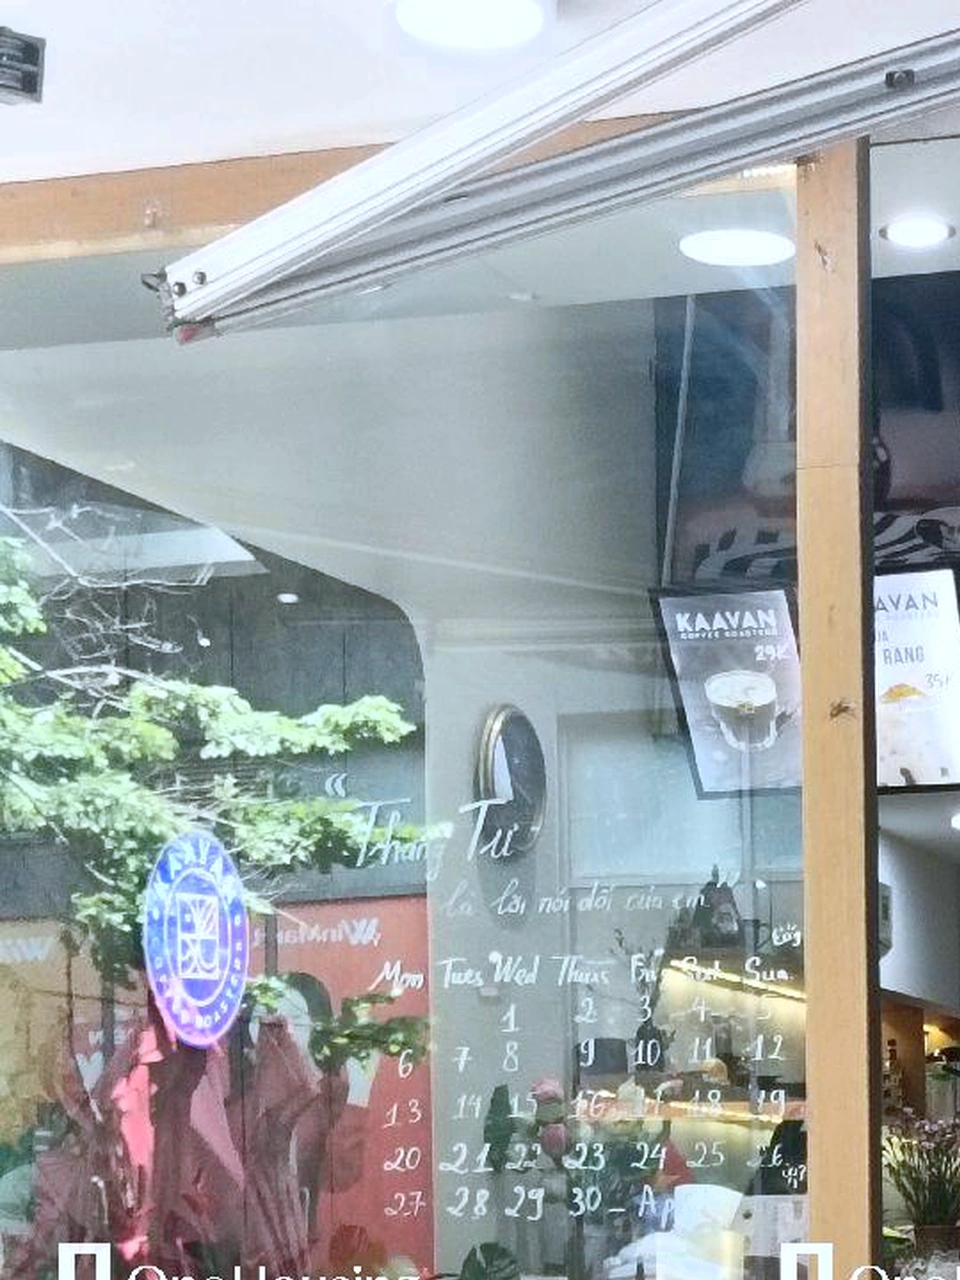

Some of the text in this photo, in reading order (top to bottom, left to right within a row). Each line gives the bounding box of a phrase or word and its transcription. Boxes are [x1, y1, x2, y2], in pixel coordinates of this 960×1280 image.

[876, 591, 938, 612] AVAN
[675, 609, 777, 632] KAAVAN
[368, 959, 425, 992] Mon
[437, 956, 485, 989] Tues
[492, 954, 541, 986] Wed
[500, 1004, 520, 1033] 1
[574, 998, 598, 1023] 2
[637, 994, 652, 1022] 3
[691, 996, 710, 1022] 4
[397, 1034, 788, 1078] 6 7 8 9 10 11 12
[382, 1099, 422, 1129] 13
[451, 1094, 482, 1120] 14
[757, 1089, 786, 1122] 19
[383, 1147, 421, 1171] 20
[439, 1142, 495, 1174] 21
[505, 1143, 543, 1170] 22
[562, 1142, 605, 1171] 23
[630, 1141, 667, 1170] 24
[685, 1142, 726, 1168] 25
[384, 1190, 427, 1217] 27
[445, 1186, 490, 1219] 28
[504, 1185, 545, 1221] 29
[569, 1186, 603, 1218] 30
